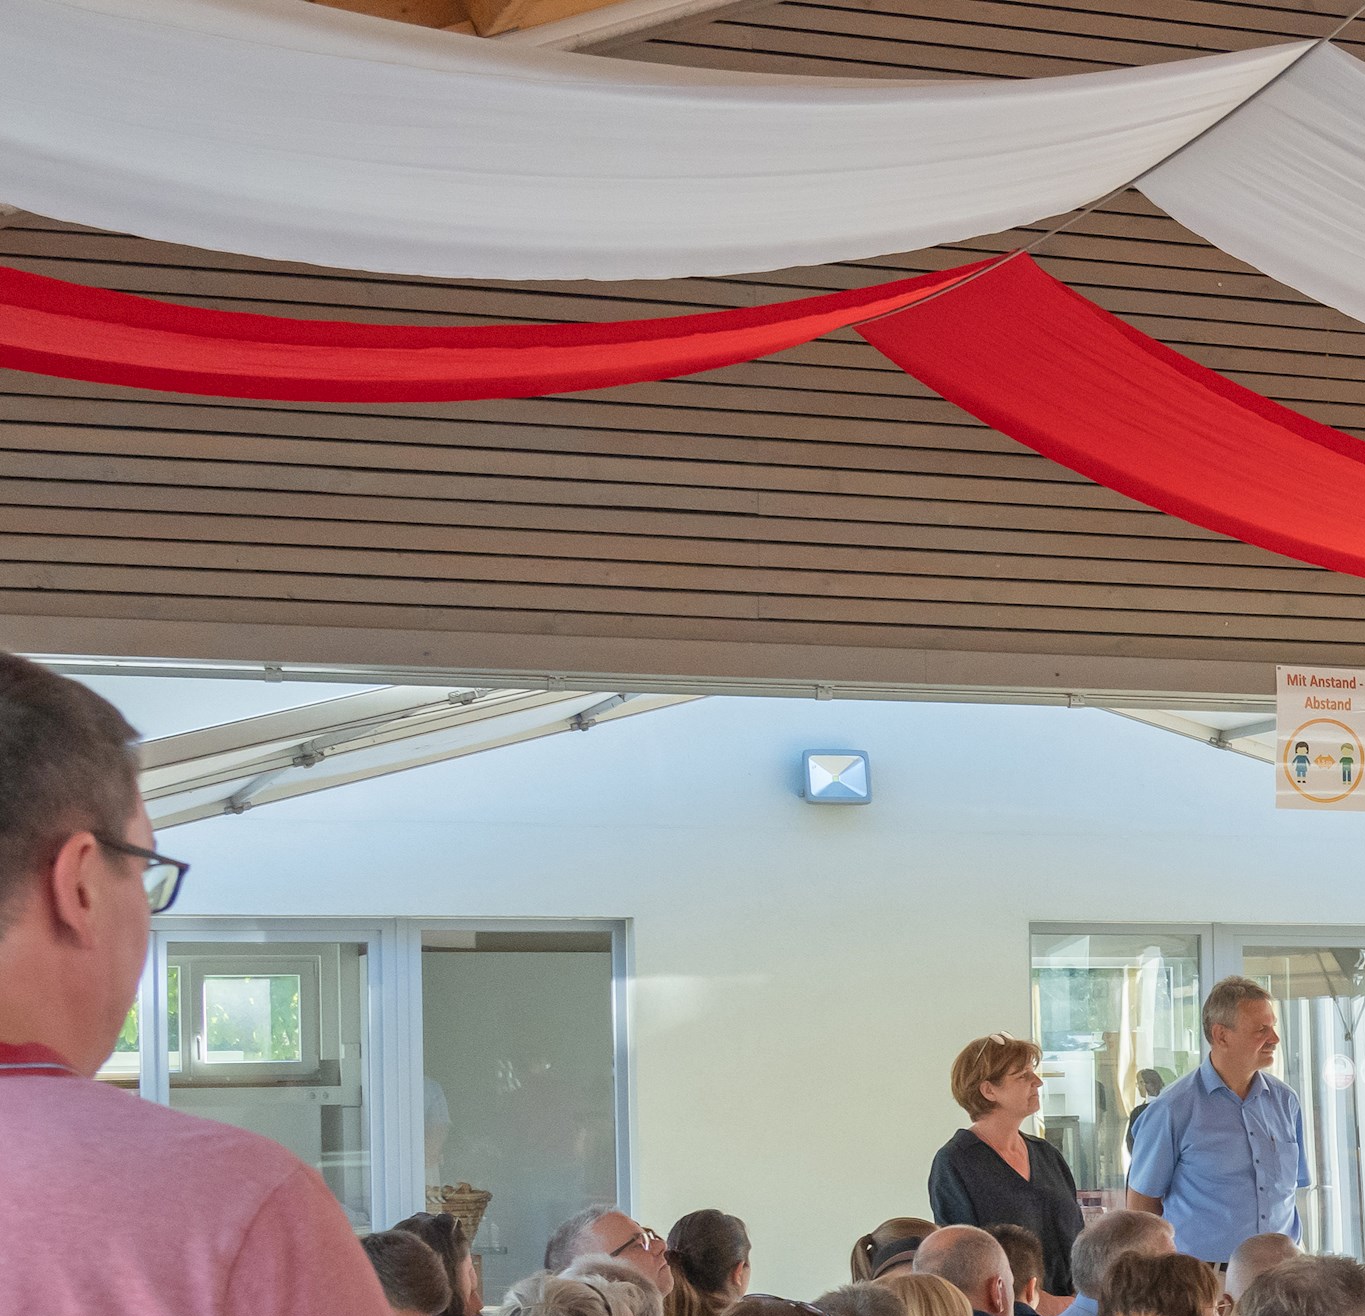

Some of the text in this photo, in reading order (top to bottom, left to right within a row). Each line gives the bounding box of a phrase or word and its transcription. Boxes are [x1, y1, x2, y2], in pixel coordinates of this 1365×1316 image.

[1287, 674, 1307, 687] Mit
[1310, 675, 1356, 689] Anstand
[1305, 696, 1351, 711] Abstand
